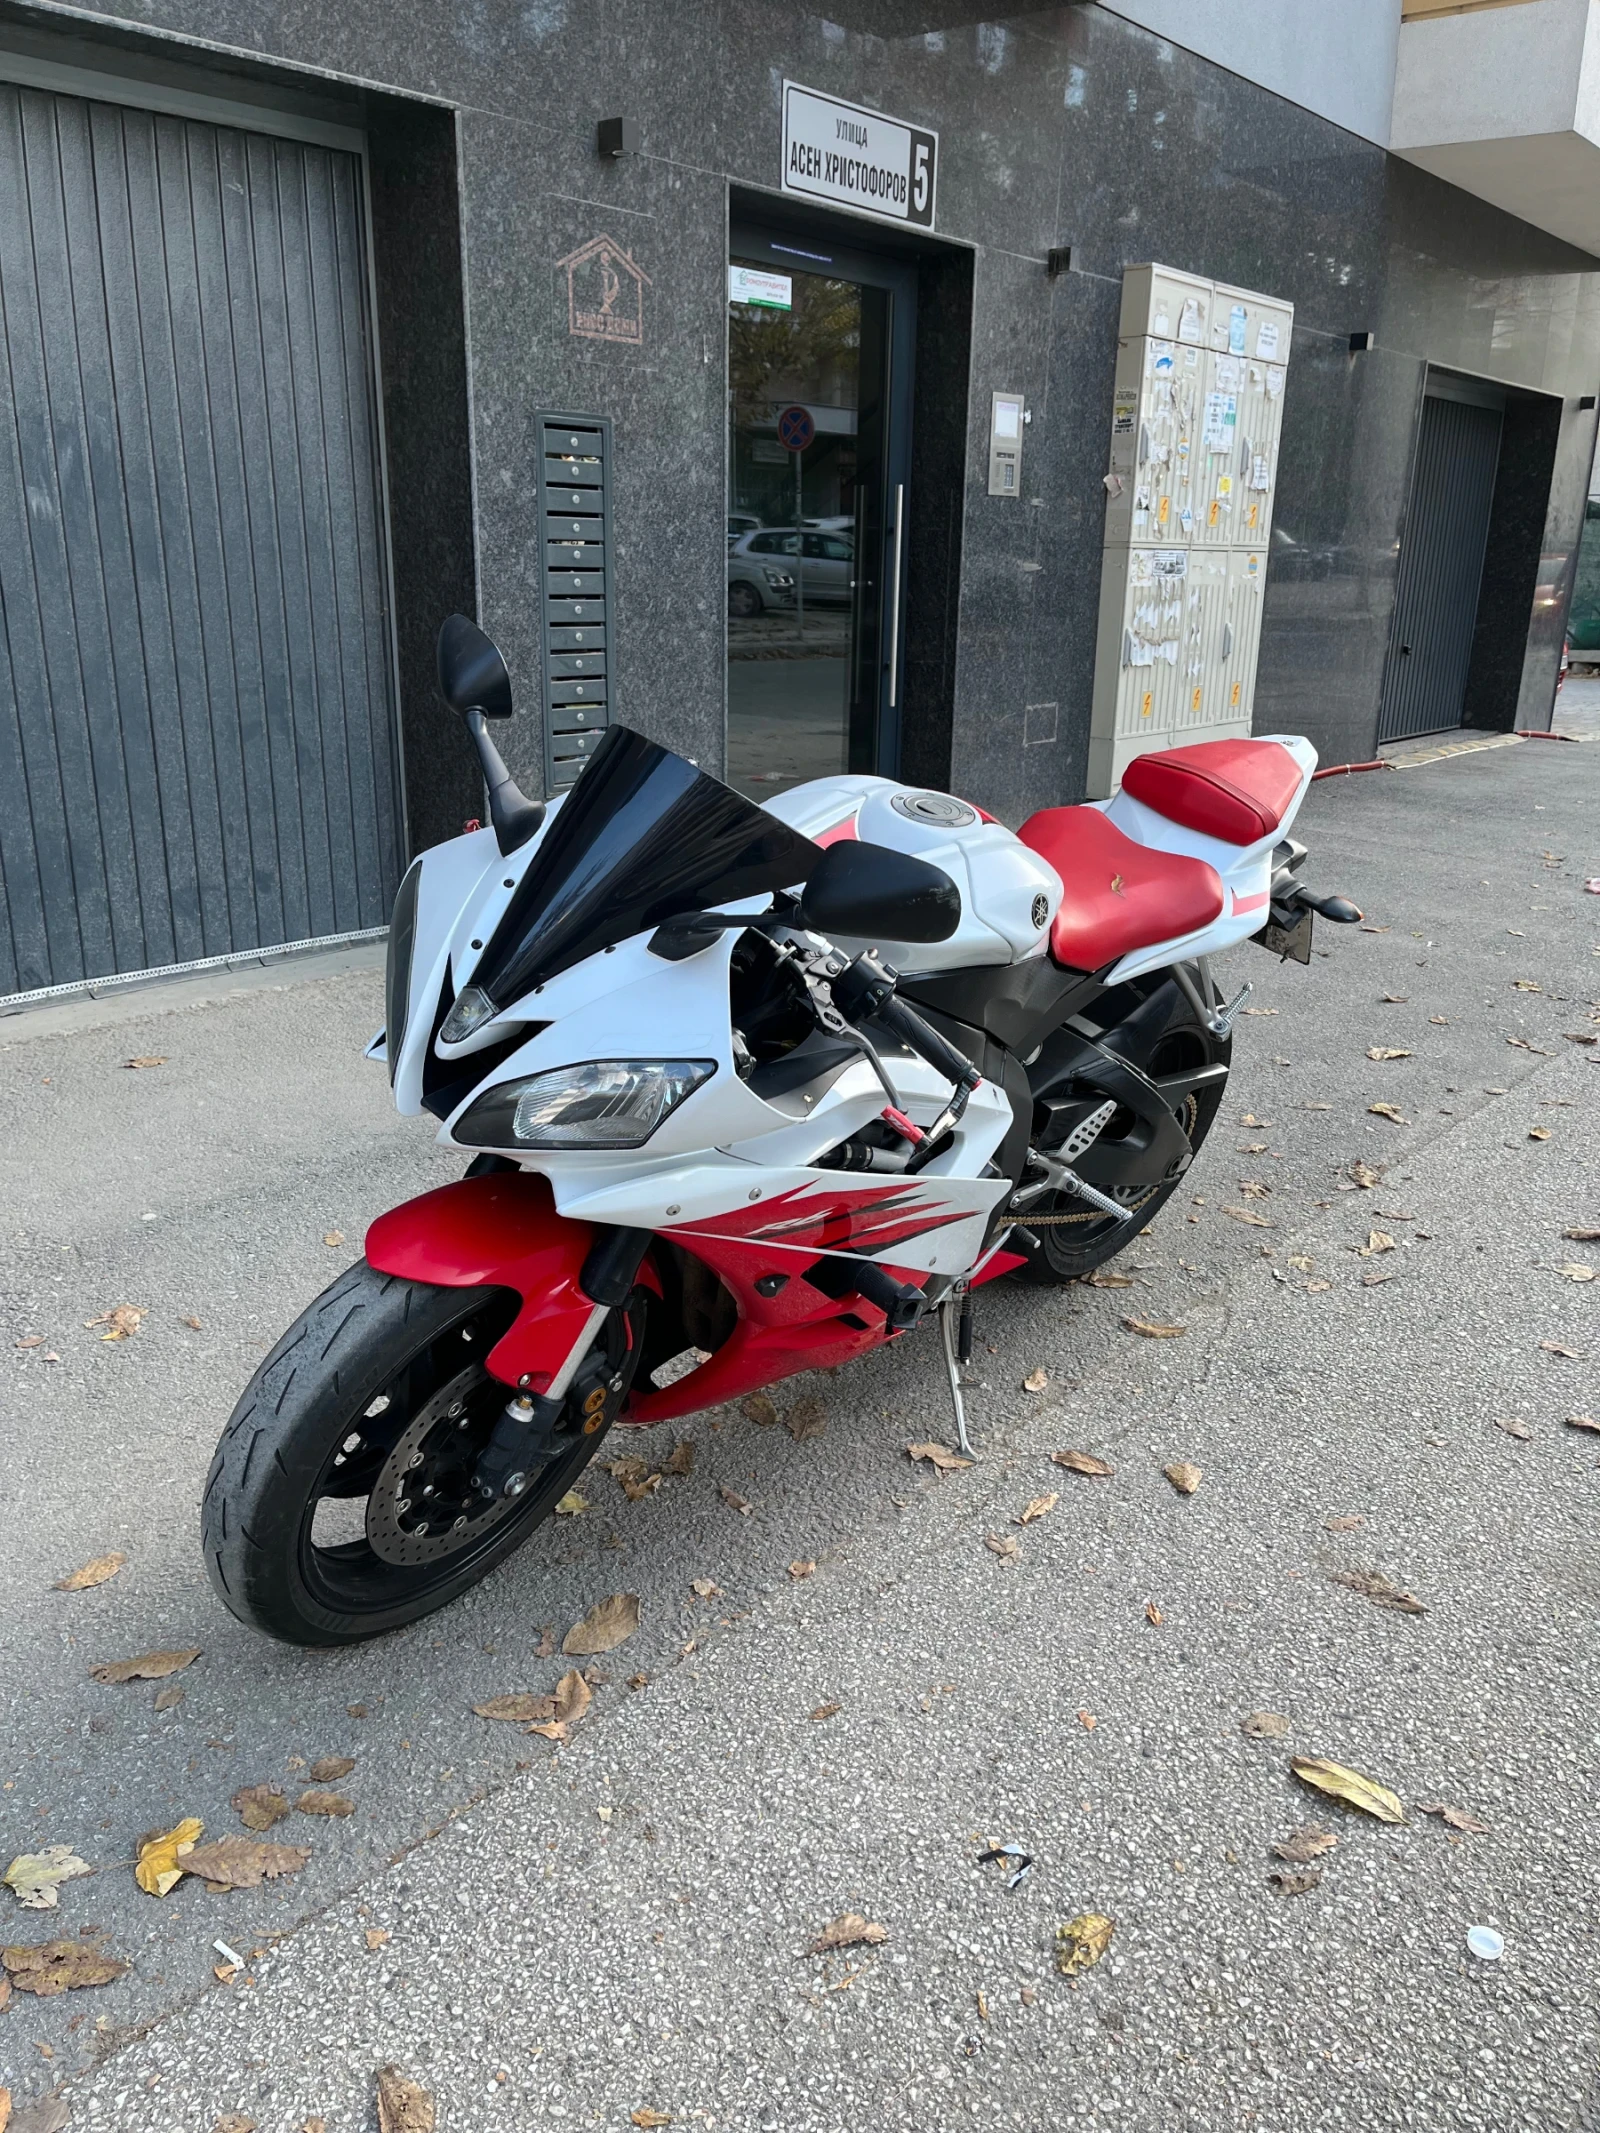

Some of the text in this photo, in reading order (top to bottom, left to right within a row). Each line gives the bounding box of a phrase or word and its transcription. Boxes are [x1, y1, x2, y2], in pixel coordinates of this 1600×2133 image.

[836, 118, 868, 150] УЛИЦА
[790, 141, 907, 203] АСЕН ХРИСТОФОРОВ
[914, 143, 929, 212] 5
